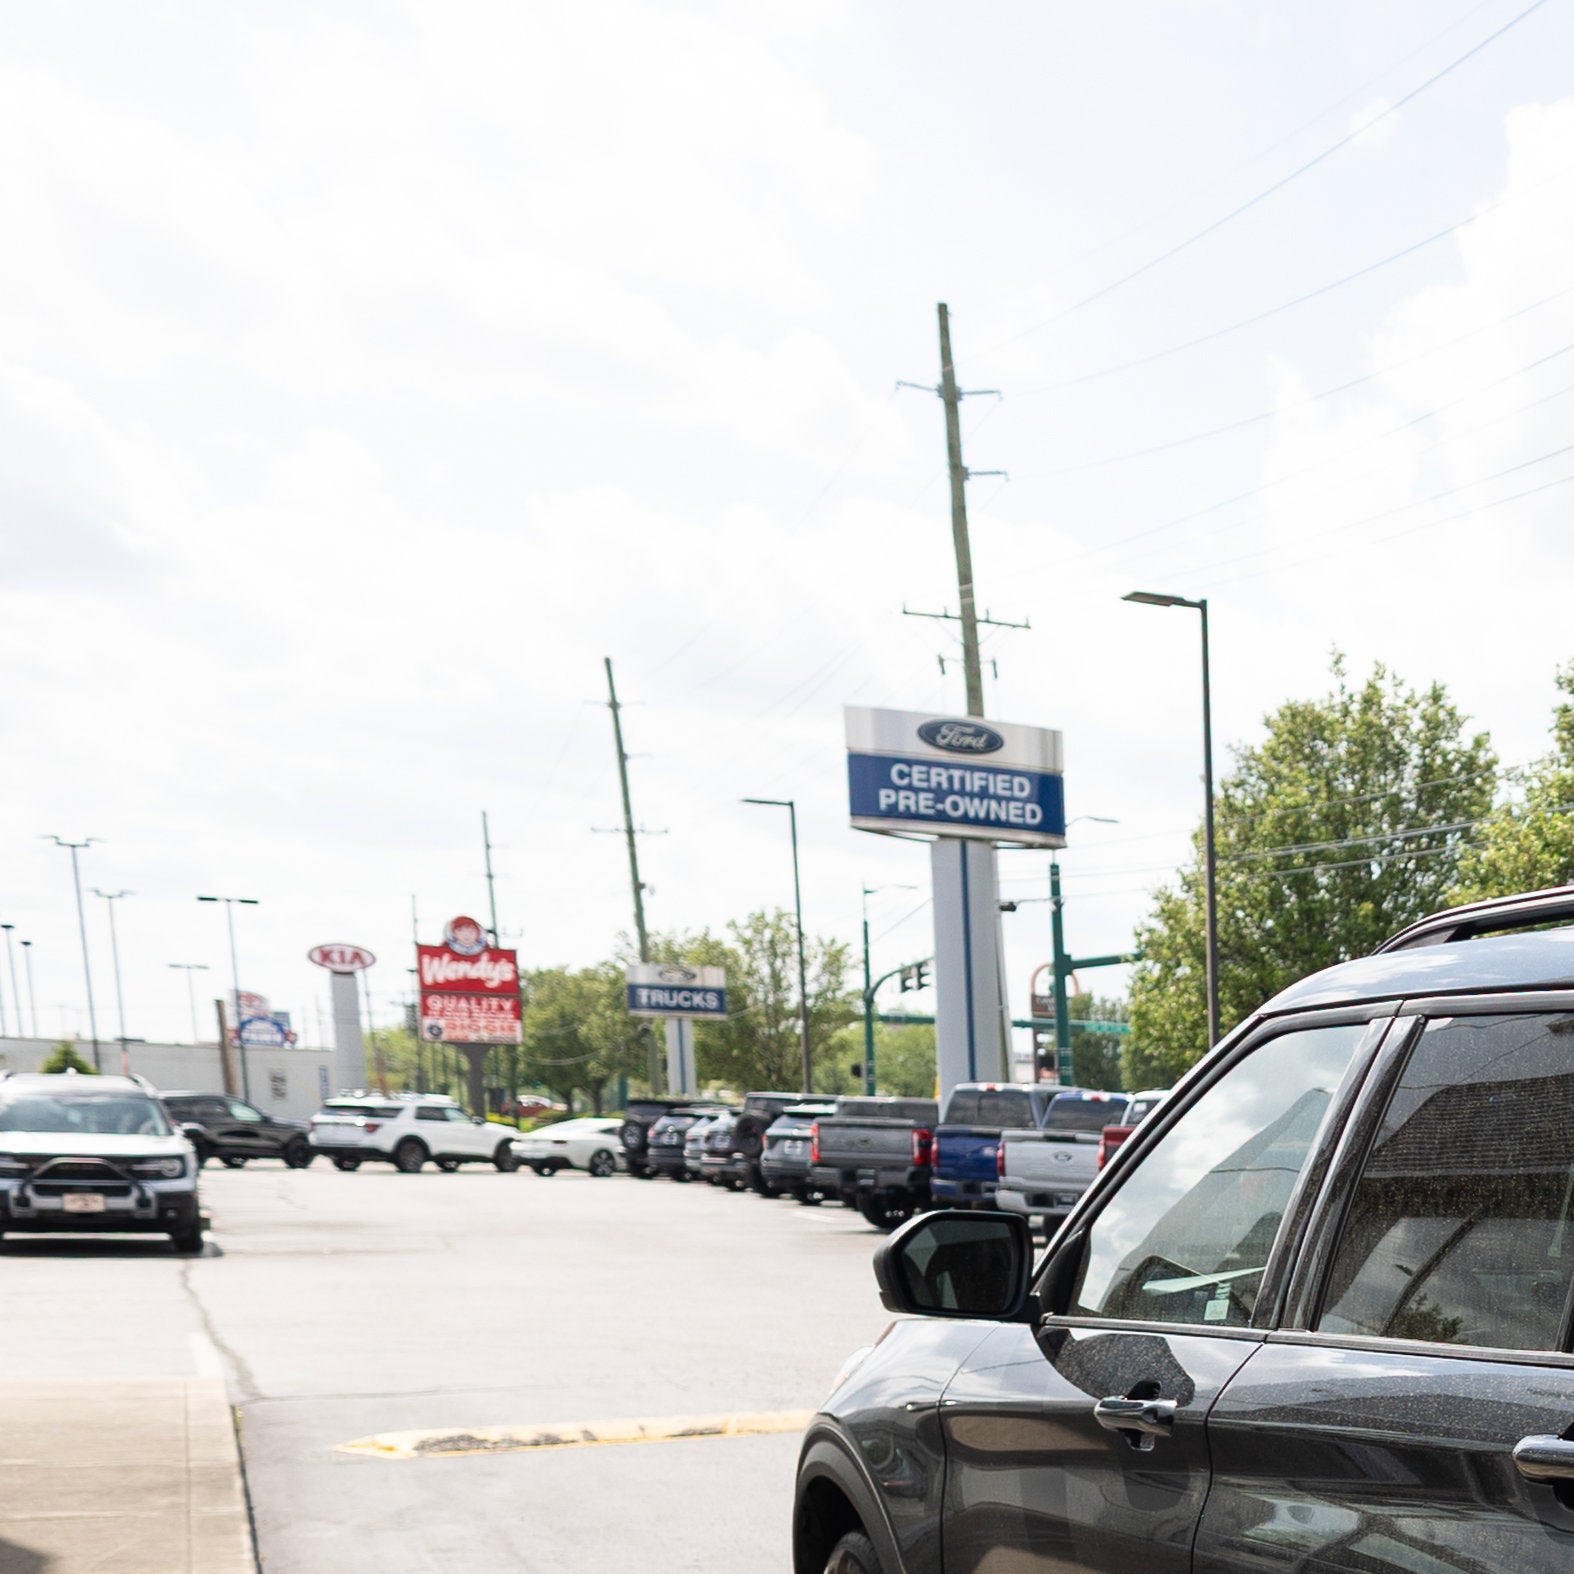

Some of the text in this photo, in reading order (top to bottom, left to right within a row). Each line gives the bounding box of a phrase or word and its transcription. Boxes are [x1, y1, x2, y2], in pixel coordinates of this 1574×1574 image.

[936, 723, 988, 750] Ford
[889, 762, 1032, 799] CERTIFIED
[878, 788, 1043, 826] PRE-OWNED
[319, 949, 366, 966] KIA
[421, 952, 516, 989] Wendy's
[637, 988, 719, 1010] TRUCKS
